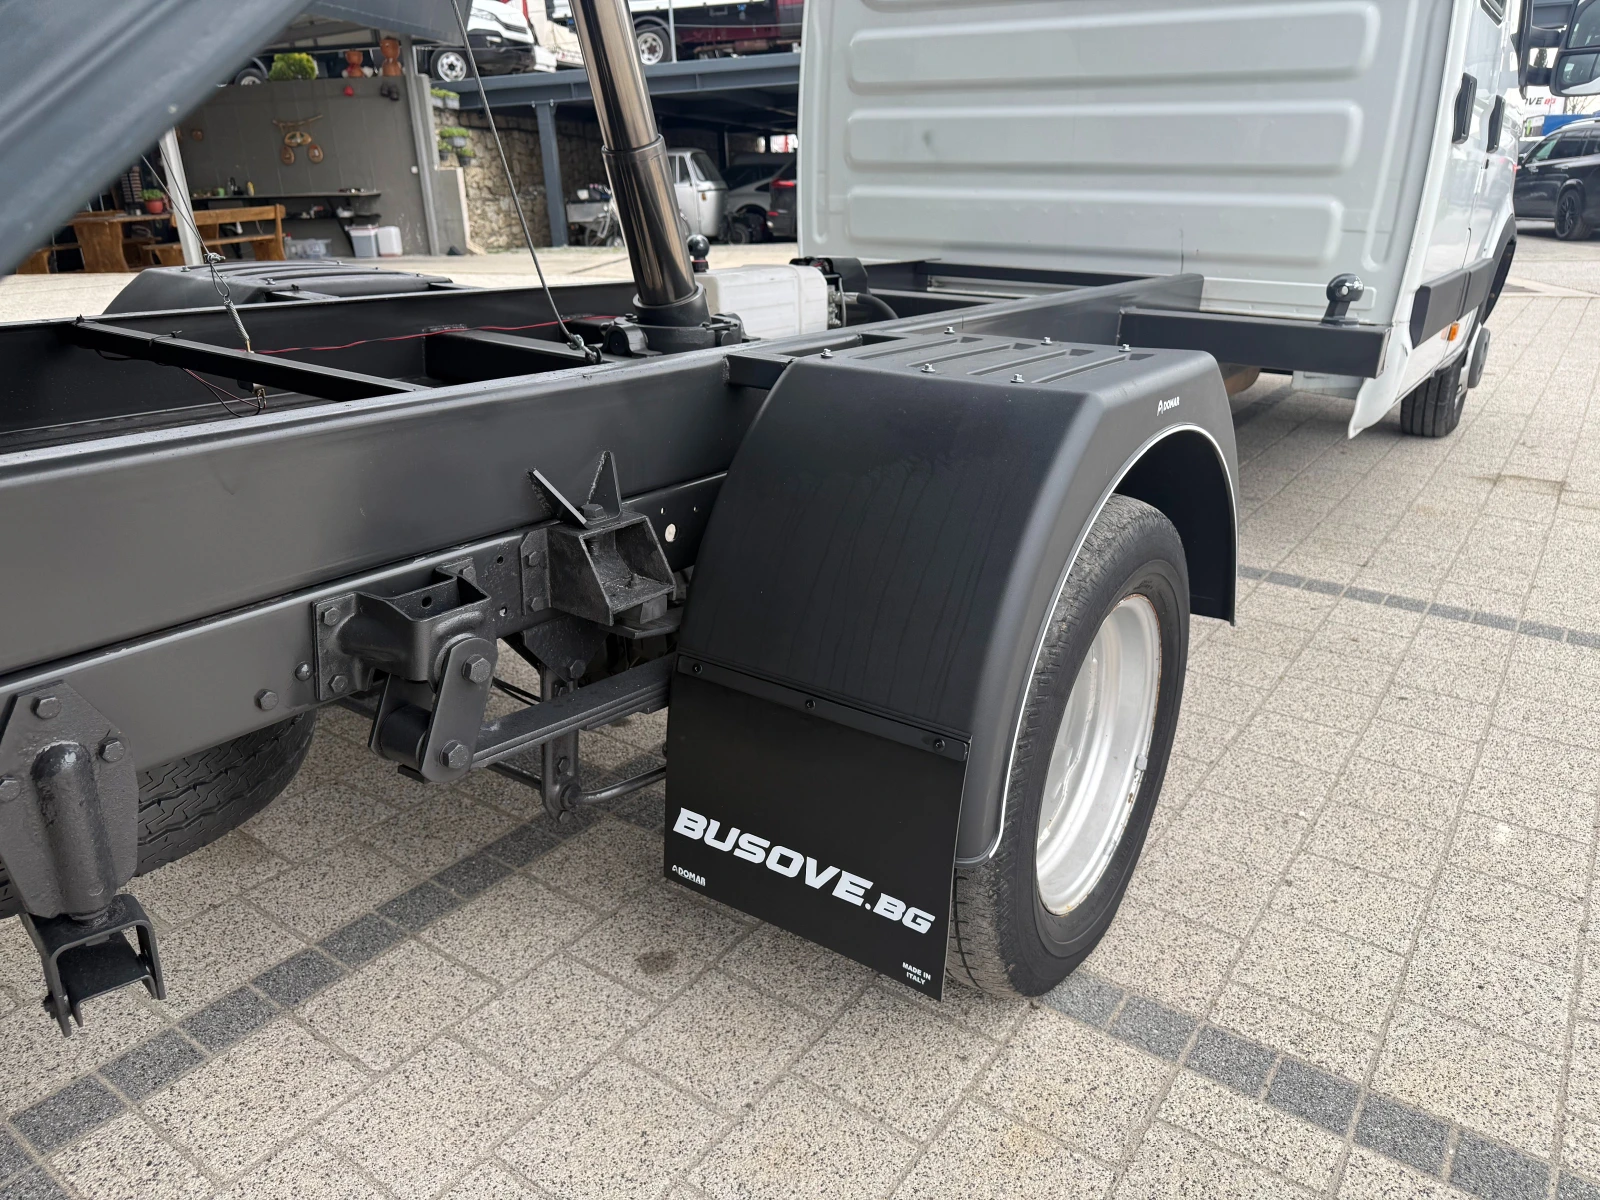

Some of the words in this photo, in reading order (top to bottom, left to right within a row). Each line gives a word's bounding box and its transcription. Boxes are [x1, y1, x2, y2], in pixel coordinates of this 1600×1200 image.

[672, 807, 936, 934] BUSOVE.BG
[902, 961, 922, 976] MADE
[923, 971, 932, 981] IN
[906, 971, 926, 985] ITALY
